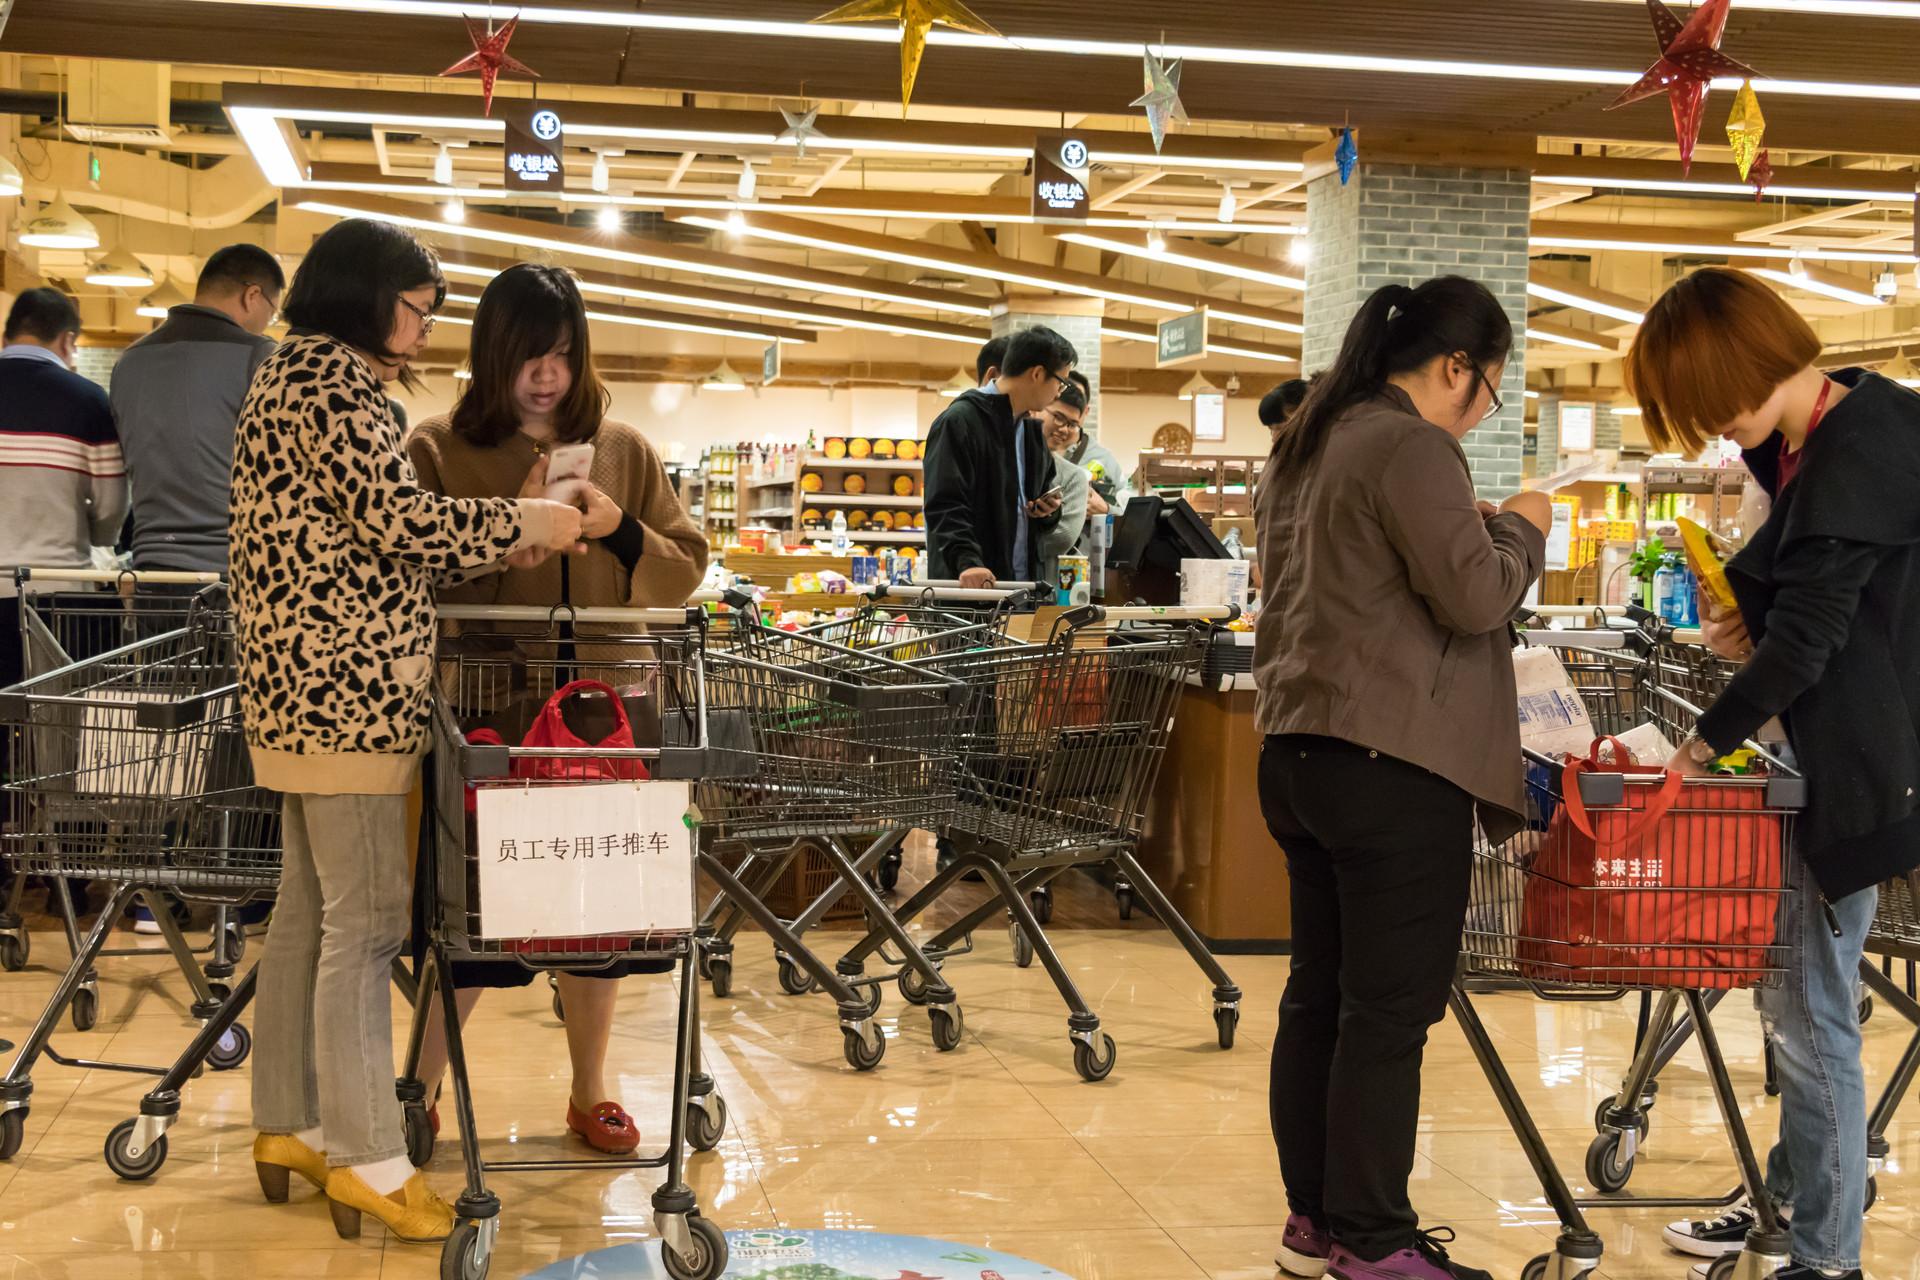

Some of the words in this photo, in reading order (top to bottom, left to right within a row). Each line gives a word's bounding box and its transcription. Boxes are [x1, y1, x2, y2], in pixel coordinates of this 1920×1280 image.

[509, 153, 559, 172] 收银处
[1039, 182, 1084, 200] 收银处
[497, 831, 670, 863] 员工专用手推车
[1592, 858, 1663, 878] 本来生活
